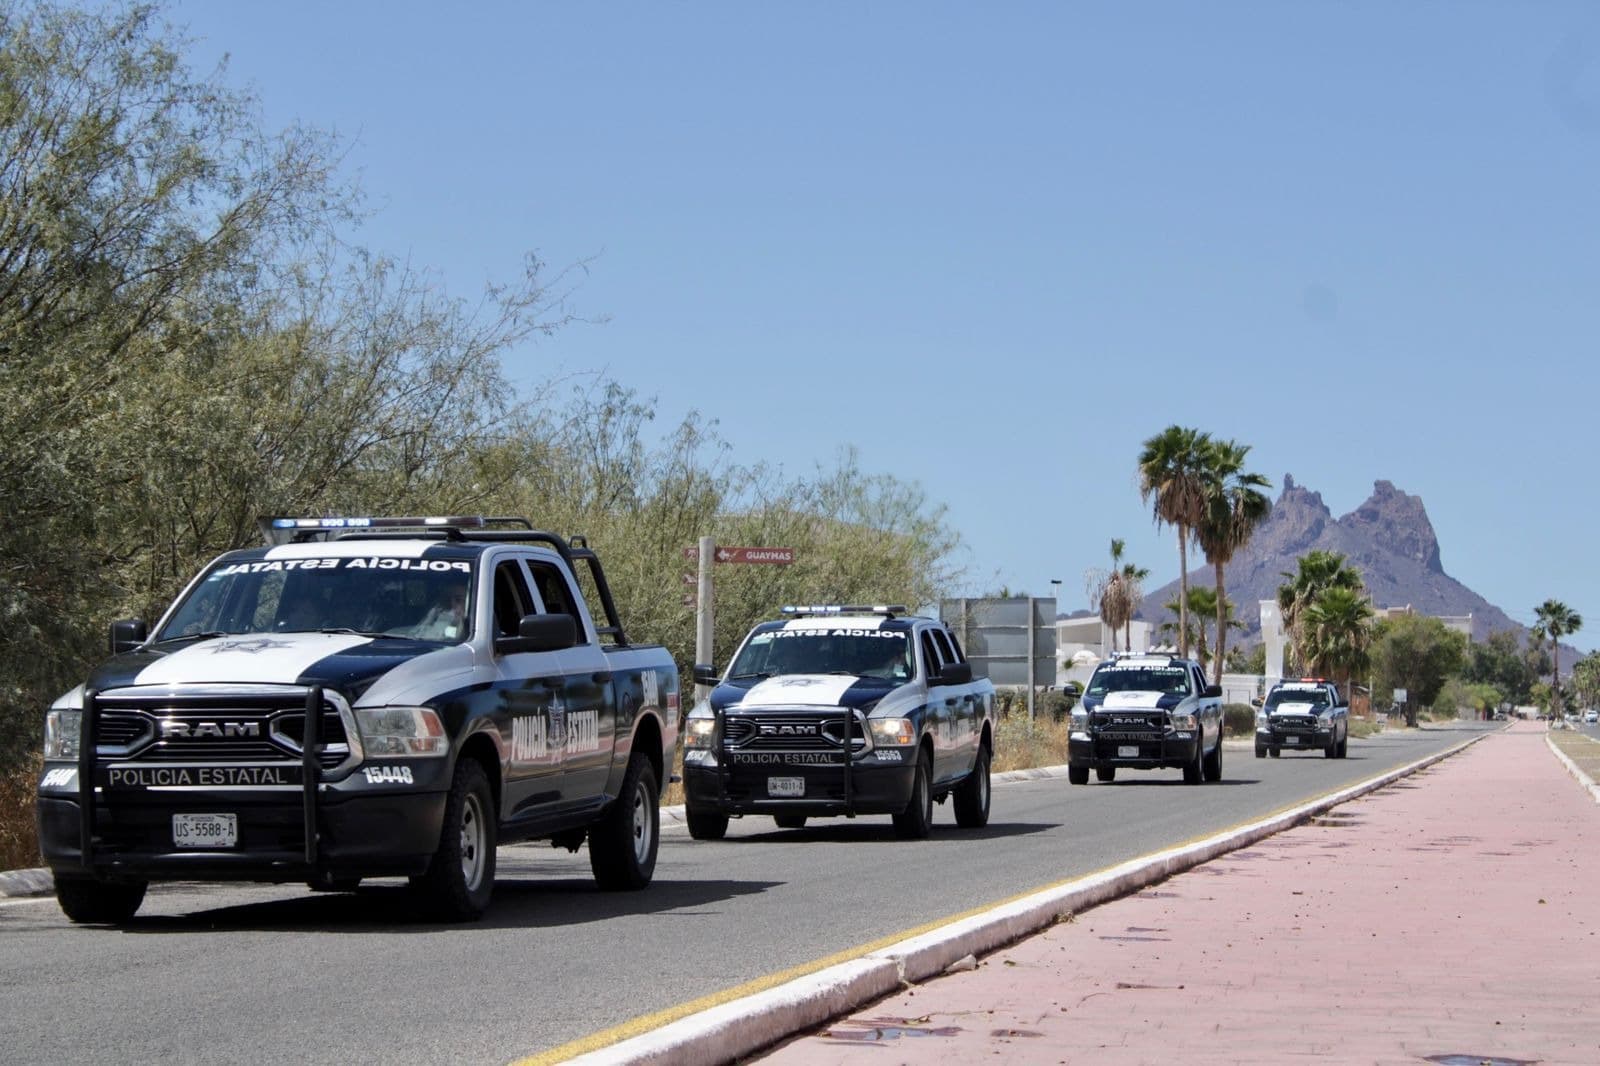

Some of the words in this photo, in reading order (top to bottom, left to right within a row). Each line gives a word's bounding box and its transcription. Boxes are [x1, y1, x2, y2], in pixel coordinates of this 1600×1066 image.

[746, 551, 792, 561] GUAYMAS
[161, 721, 260, 738] RAM
[760, 725, 817, 735] RAM
[733, 754, 781, 764] POLICIA
[785, 754, 836, 763] ESTATAL
[109, 769, 192, 786] POLICIA
[199, 768, 288, 785] ESTATAL
[362, 766, 414, 785] 15448
[175, 822, 235, 838] US-5588-A
